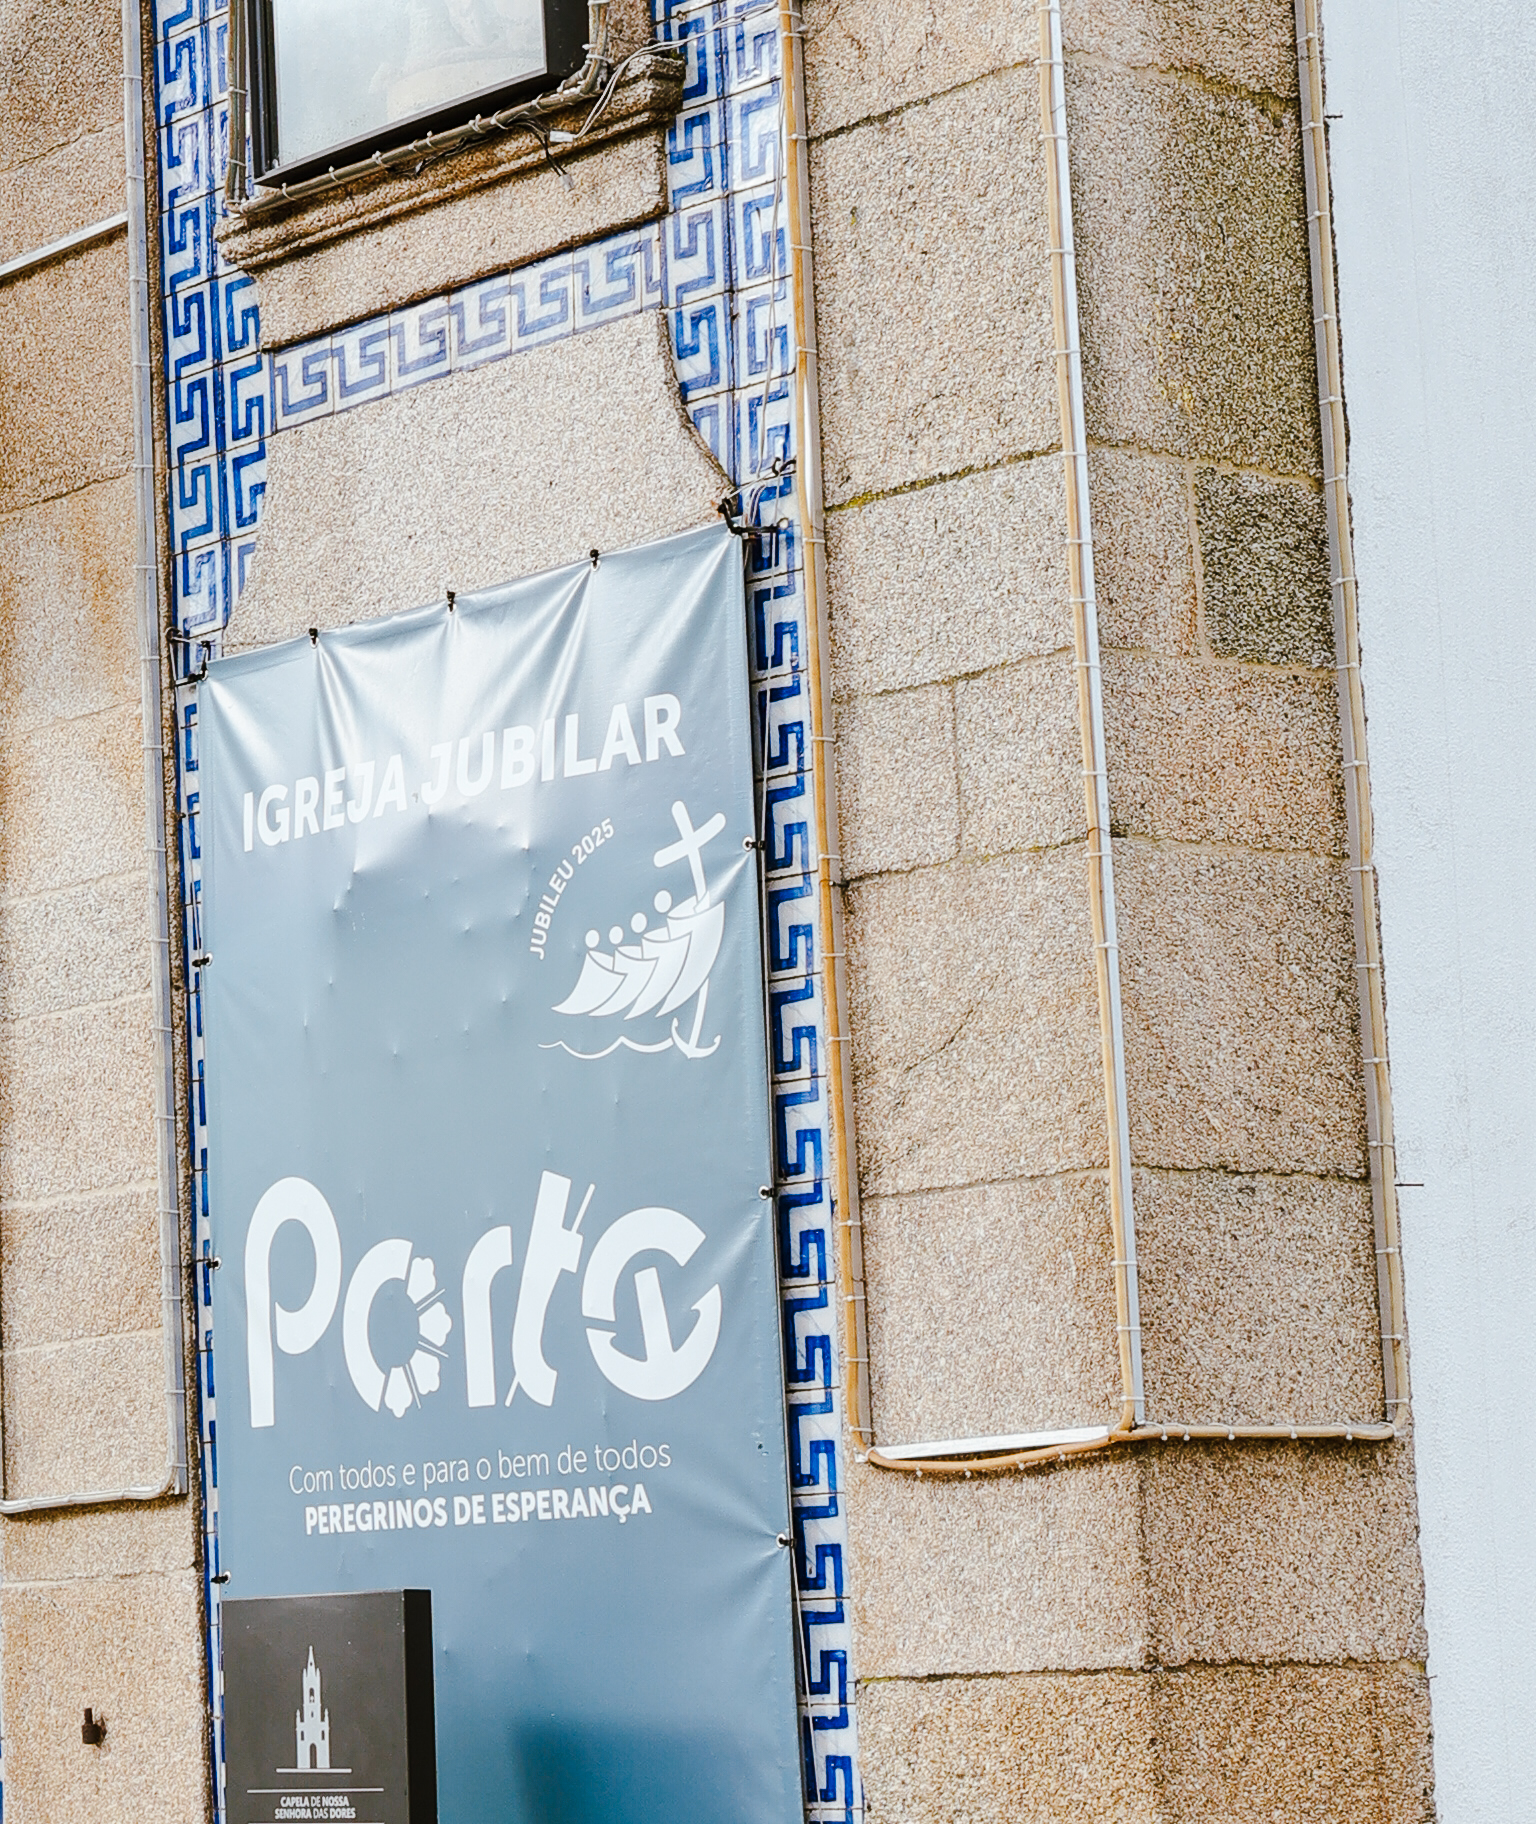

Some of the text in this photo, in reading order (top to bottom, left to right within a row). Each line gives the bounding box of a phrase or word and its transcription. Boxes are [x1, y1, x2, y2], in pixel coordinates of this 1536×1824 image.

[242, 693, 686, 852] IGREJA JUBILAR
[529, 817, 615, 961] JUBILEU 2025
[245, 1170, 722, 1428] Porto
[289, 1439, 672, 1494] Com todos e para o bem de todos
[305, 1483, 652, 1536] PEREGRINOS DE ESPERANÇA
[274, 1807, 356, 1819] SENHORA DAS DORES
[280, 1795, 350, 1807] CAPELA DE NOSSA
